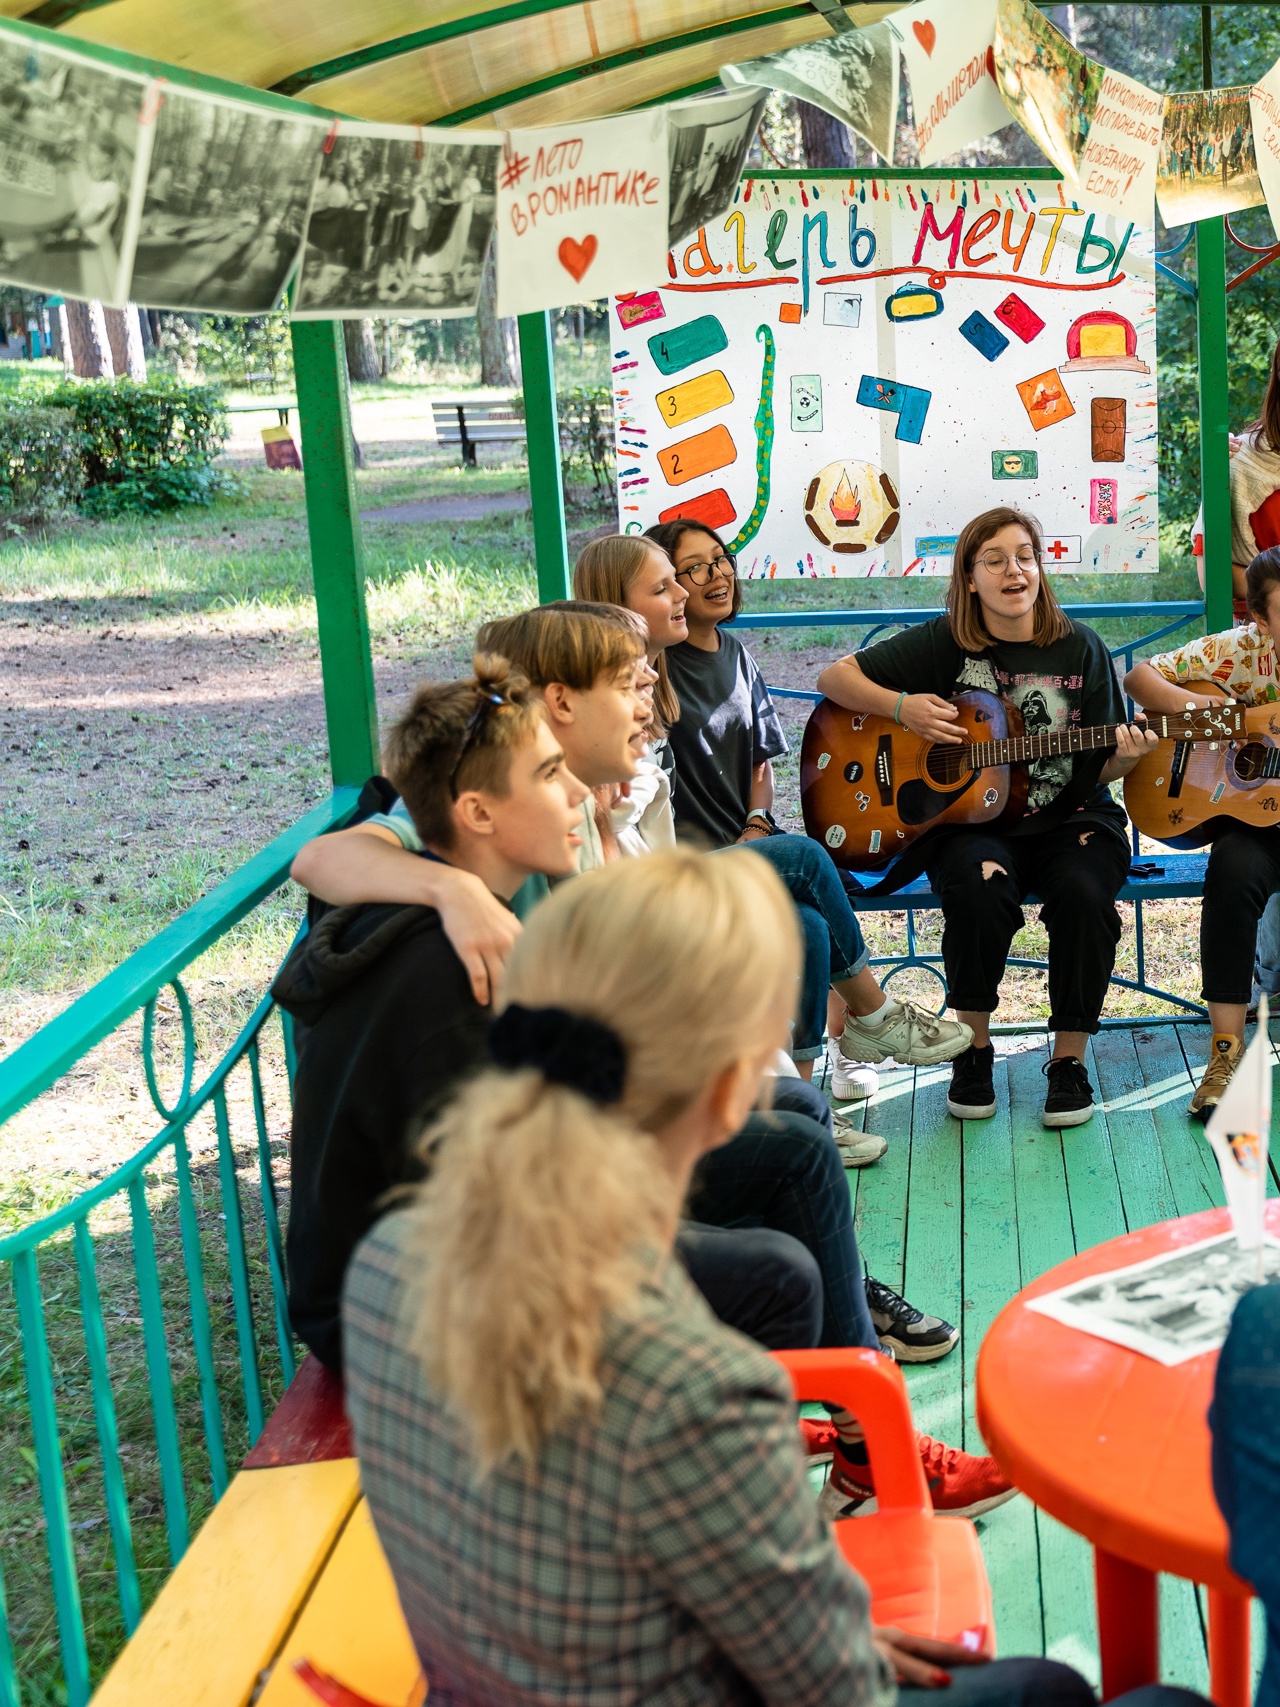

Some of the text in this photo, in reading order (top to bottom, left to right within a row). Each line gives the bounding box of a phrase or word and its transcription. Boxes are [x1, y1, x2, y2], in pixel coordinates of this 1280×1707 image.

[667, 204, 877, 317] агерь
[1002, 301, 1017, 315] 6
[968, 323, 985, 336] 5
[661, 341, 670, 362] 4
[668, 395, 677, 417] 3
[671, 454, 684, 476] 2
